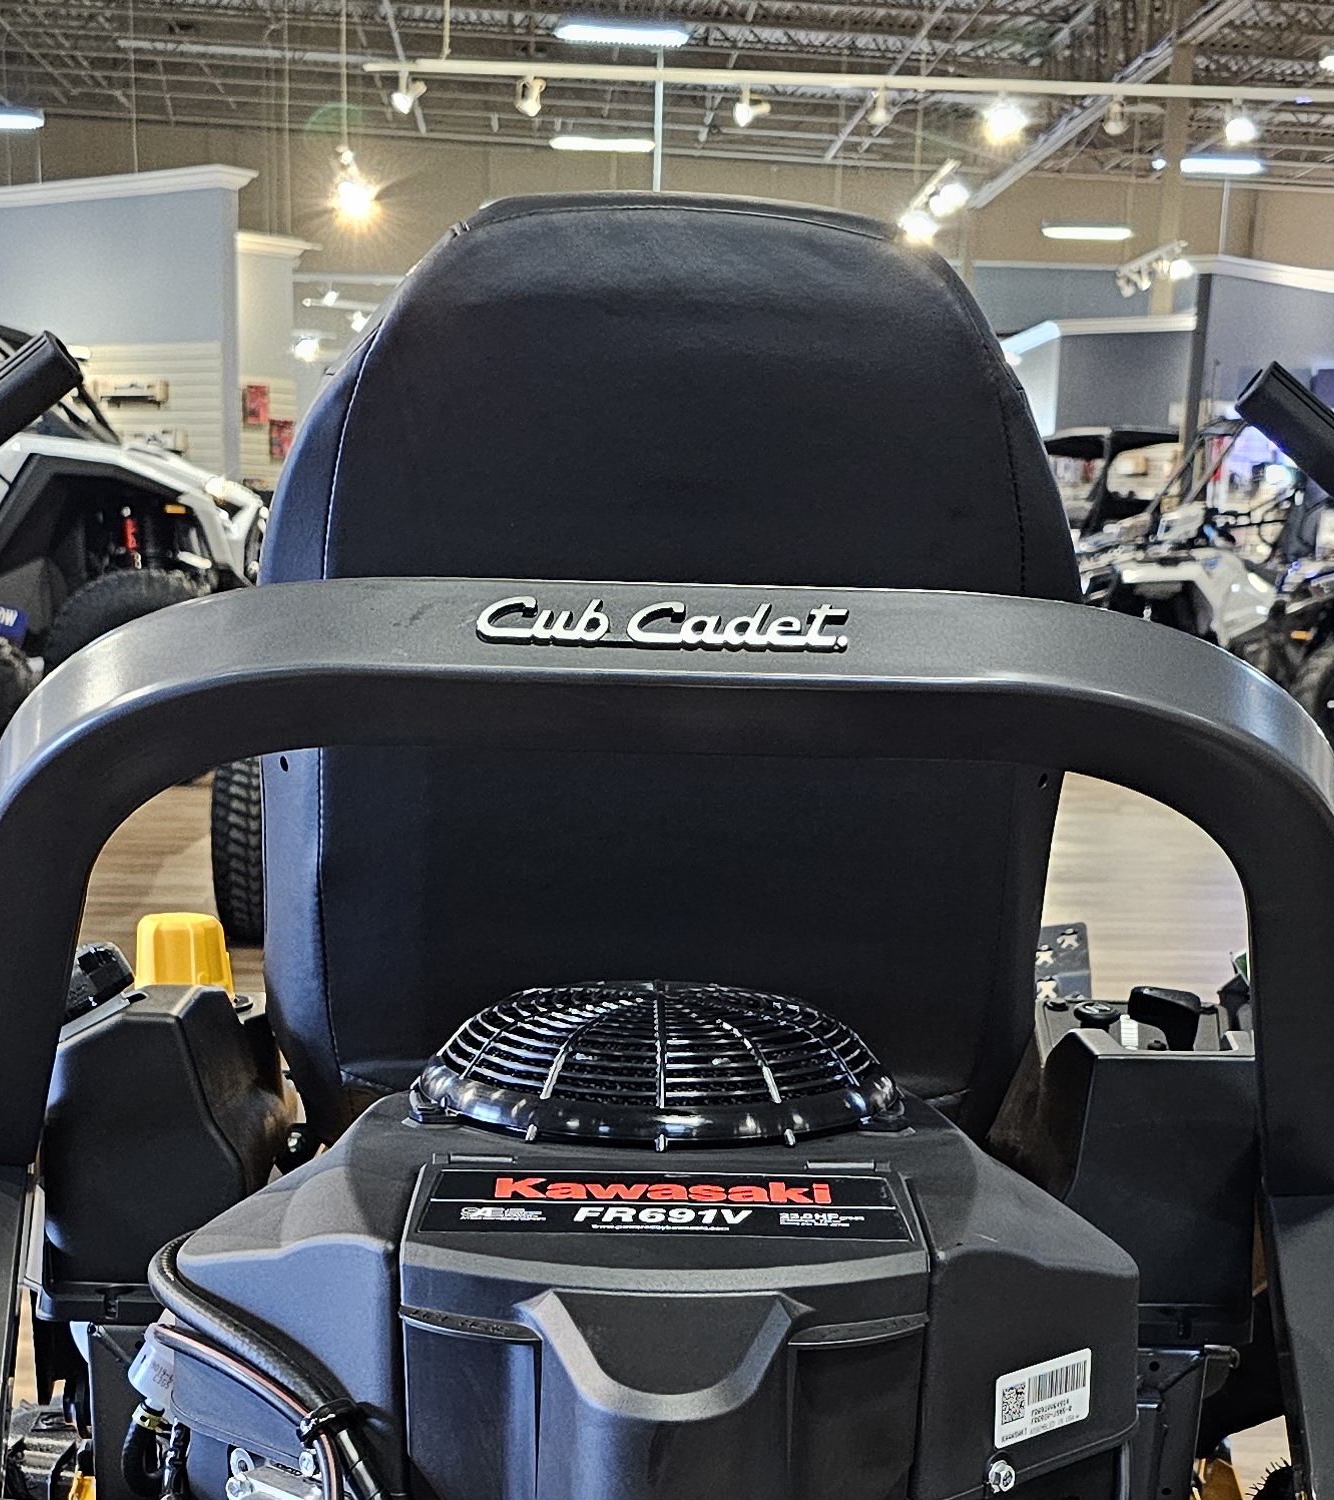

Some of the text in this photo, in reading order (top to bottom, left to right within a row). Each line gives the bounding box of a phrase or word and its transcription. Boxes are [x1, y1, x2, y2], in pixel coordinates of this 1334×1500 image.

[476, 596, 611, 645] Cub
[494, 1177, 831, 1205] Kawasaki
[573, 1206, 752, 1224] FR691V
